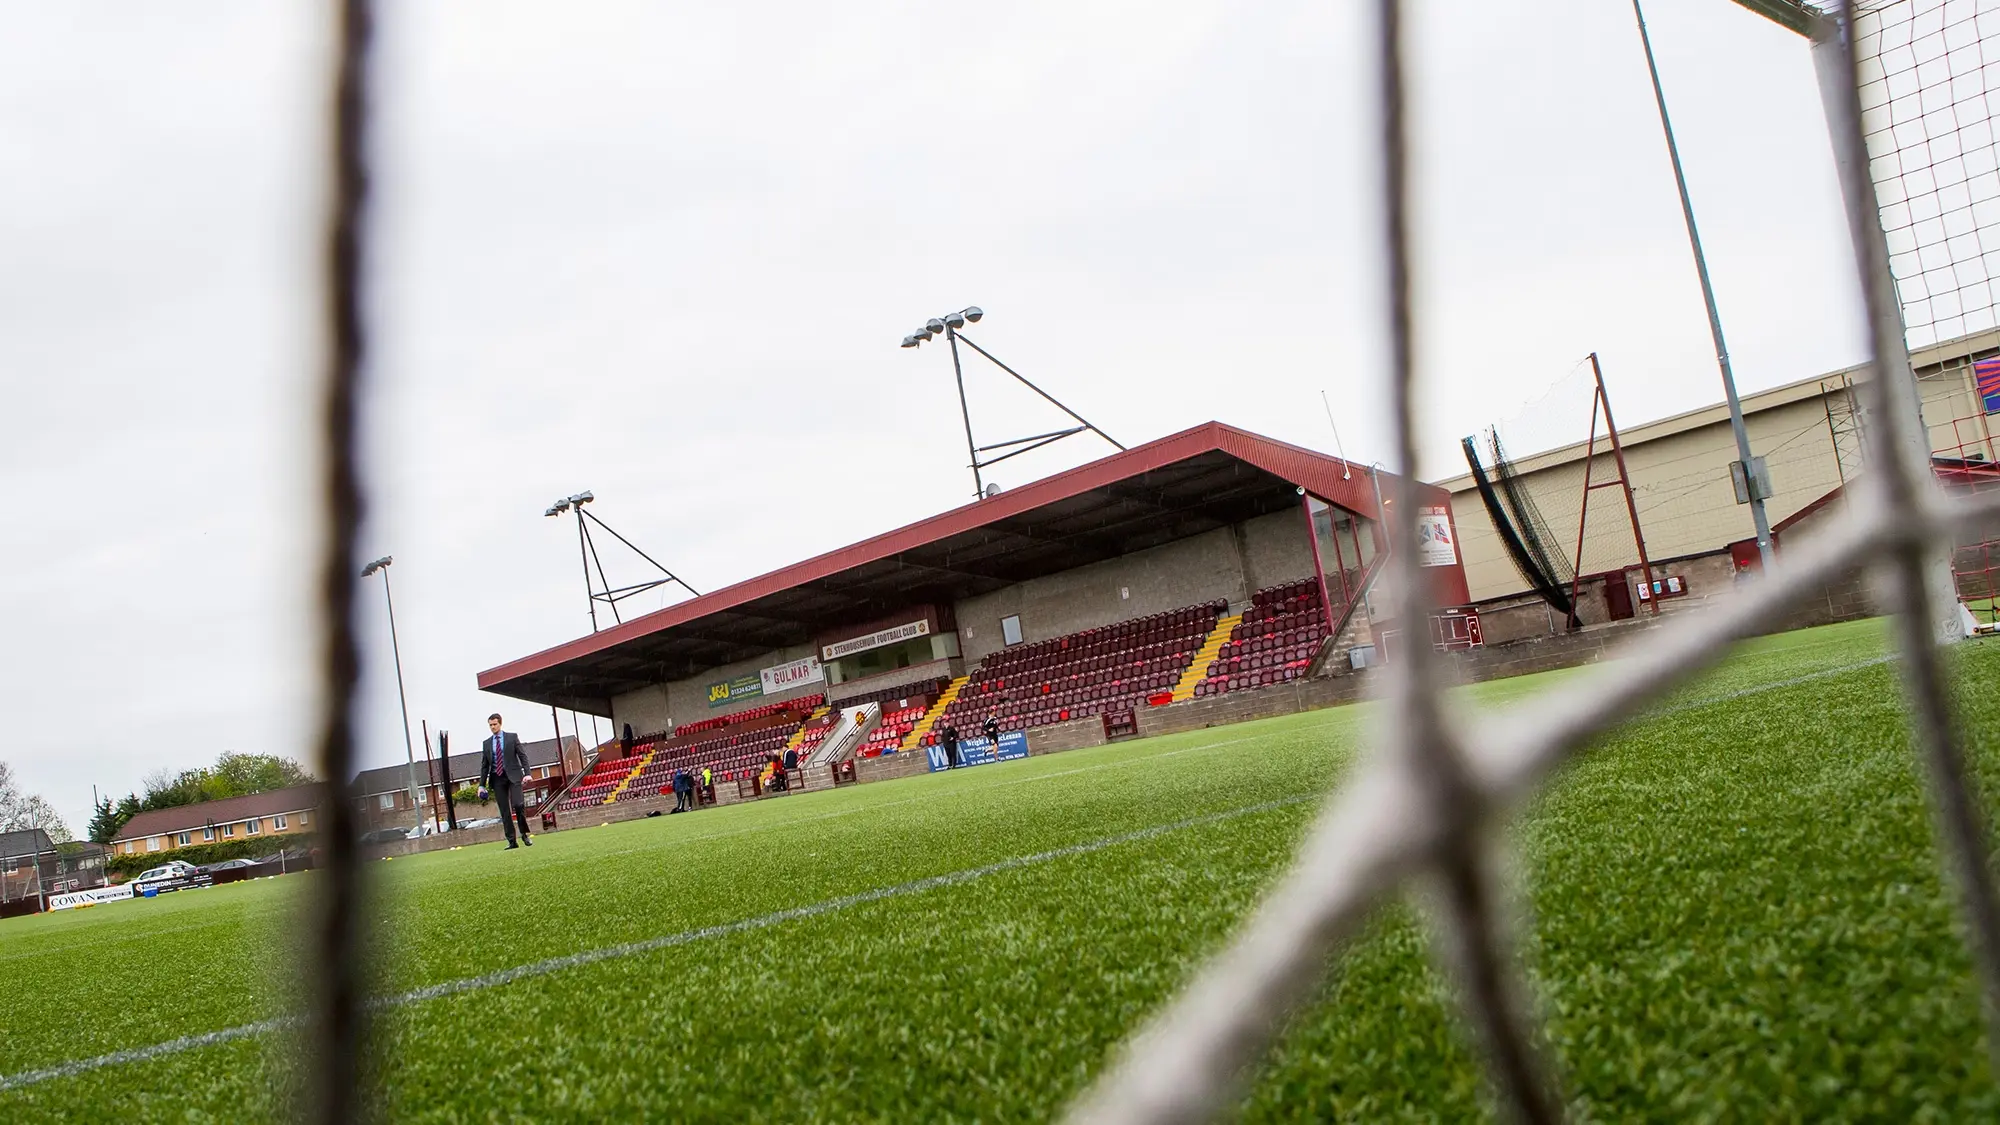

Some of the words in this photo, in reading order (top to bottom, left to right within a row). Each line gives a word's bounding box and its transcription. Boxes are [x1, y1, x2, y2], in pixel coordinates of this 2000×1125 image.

[834, 636, 876, 655] STENHOUSEMUIR
[877, 629, 902, 644] FOOTBALL
[902, 625, 917, 637] CLUB
[774, 665, 809, 684] GULNAR
[709, 683, 729, 702] J&J
[966, 738, 985, 748] Wright
[51, 892, 96, 907] COWAN
